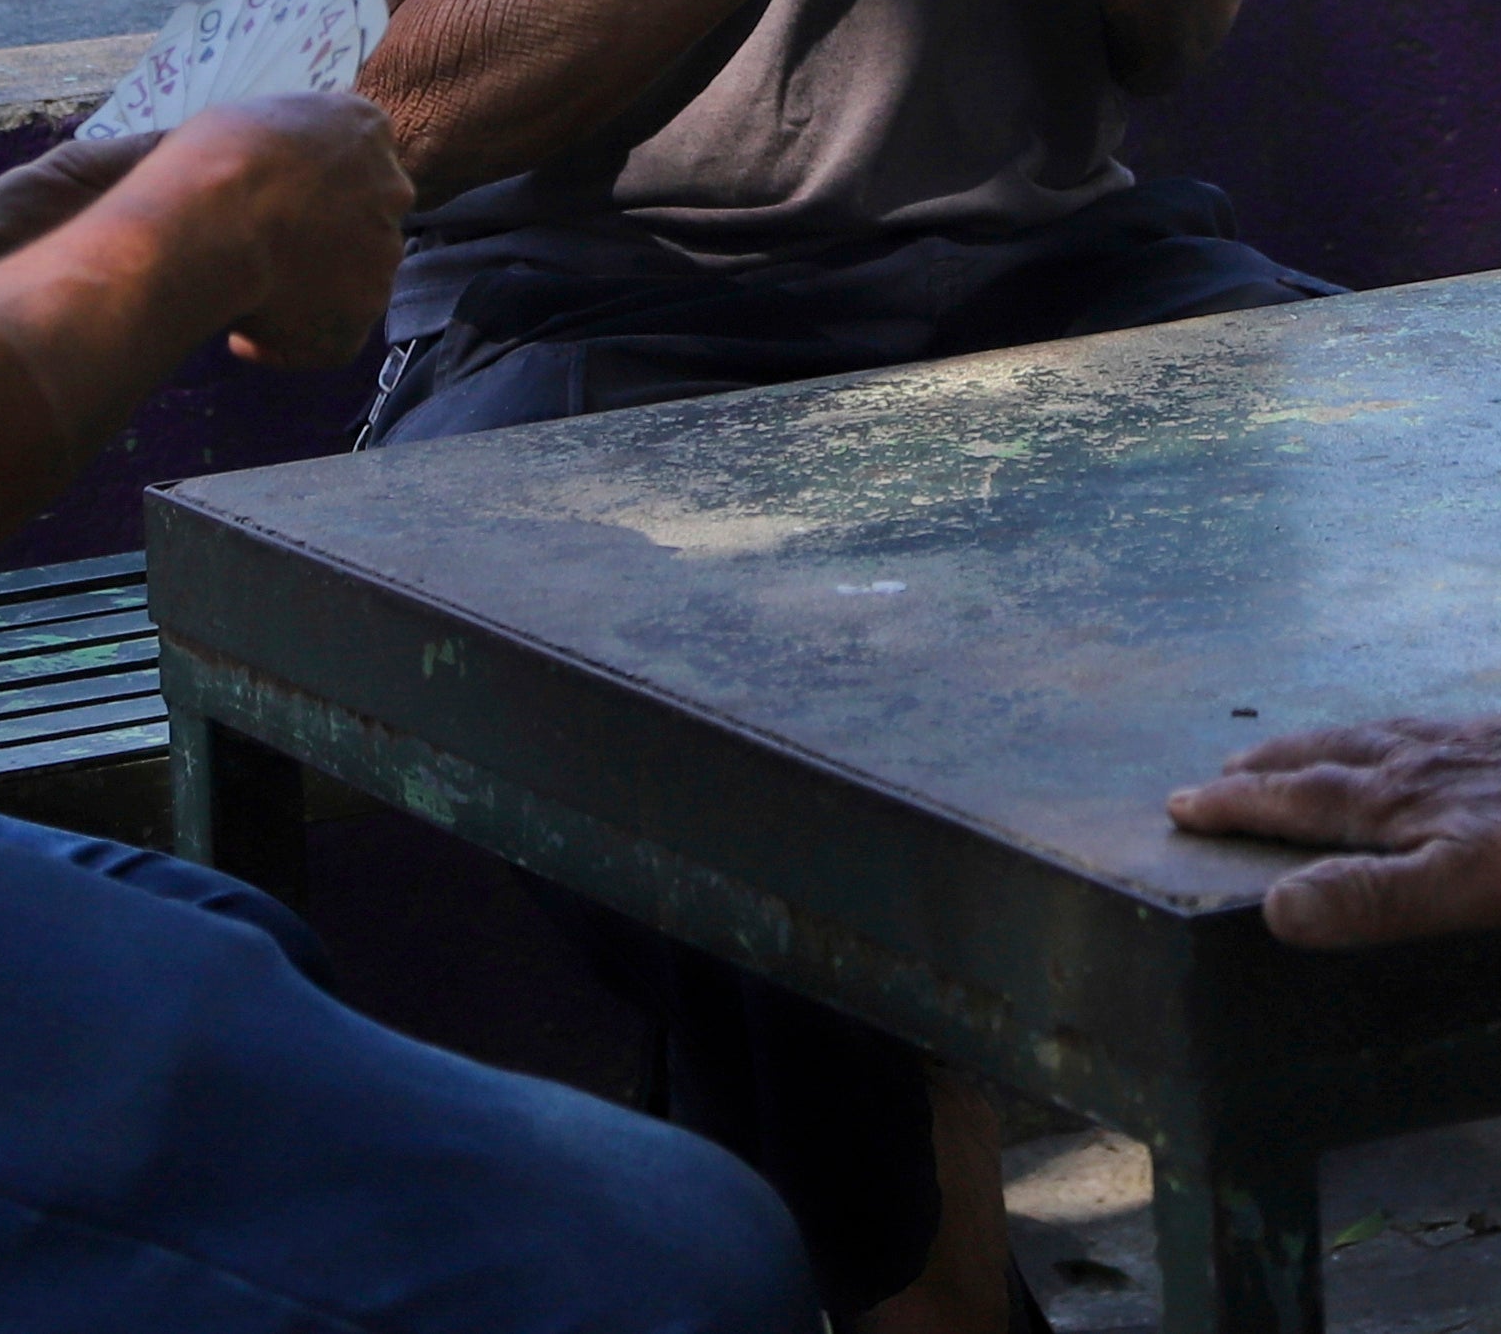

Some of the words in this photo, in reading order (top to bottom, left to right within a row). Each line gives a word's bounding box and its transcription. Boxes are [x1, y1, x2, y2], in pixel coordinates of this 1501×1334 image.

[200, 9, 222, 43] 9
[150, 45, 179, 85] K
[127, 76, 149, 110] J
